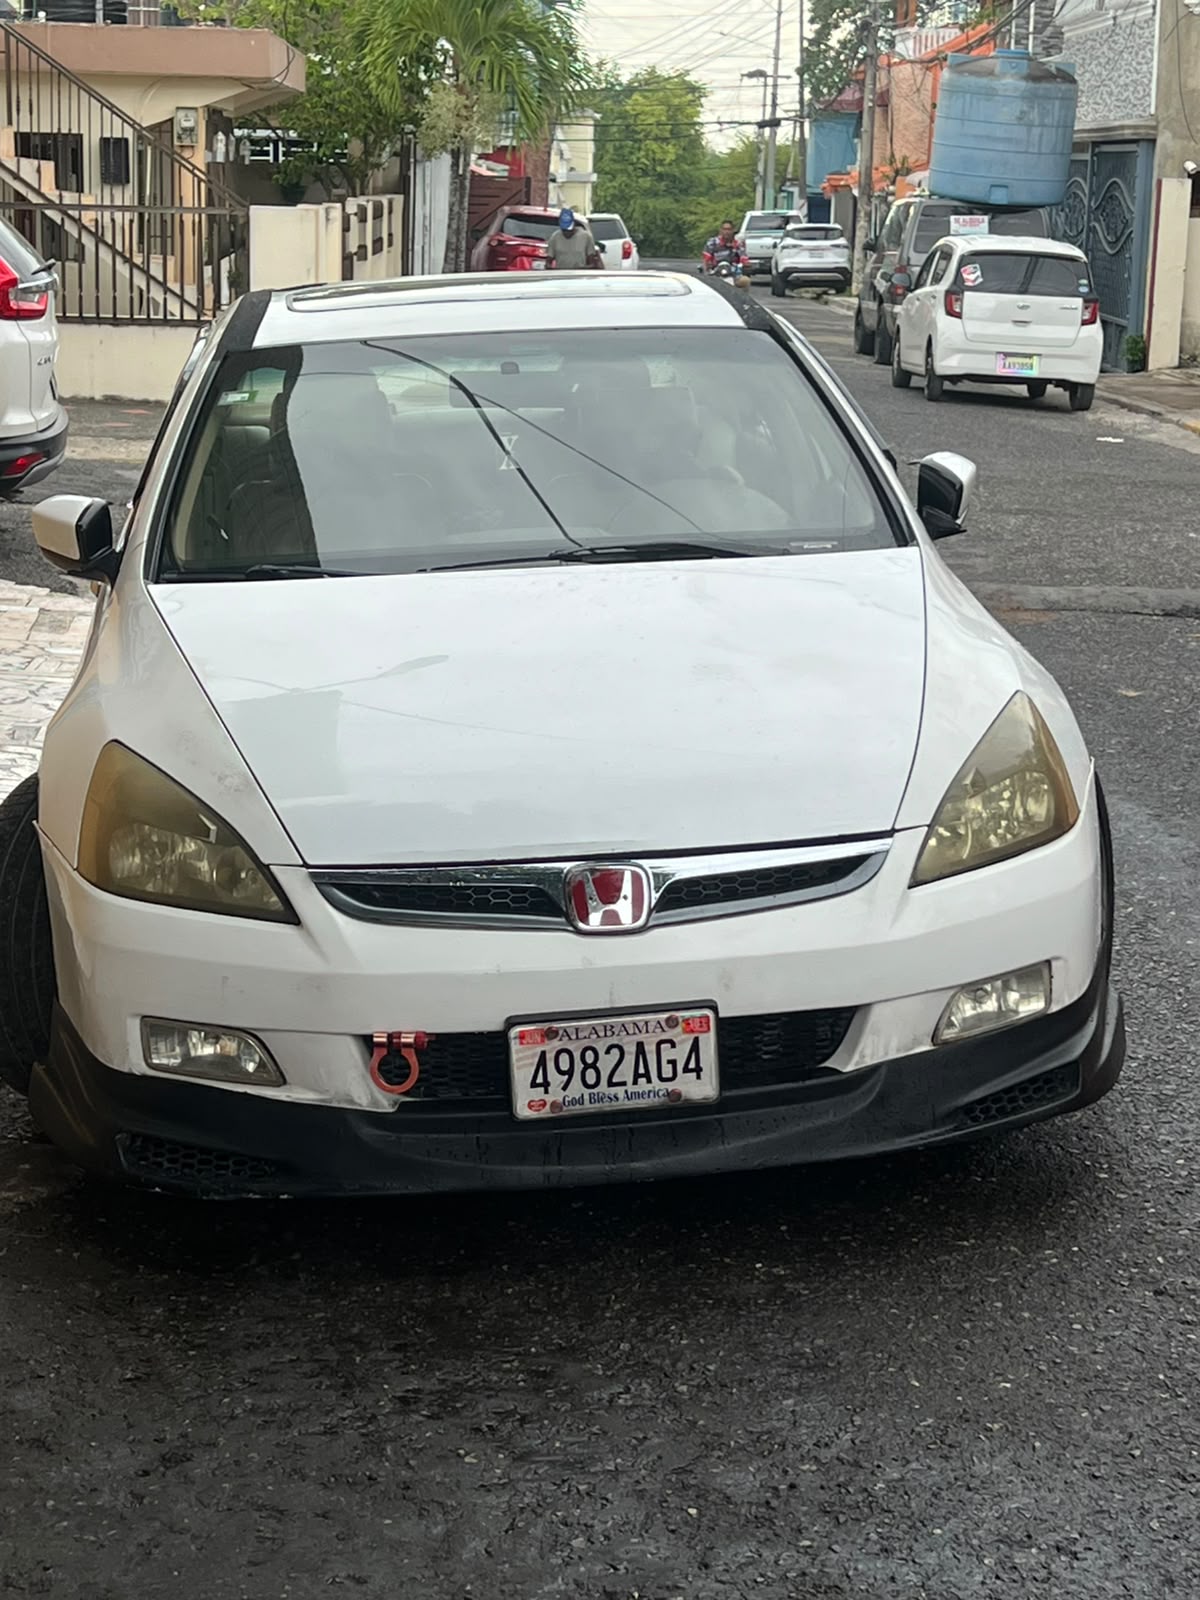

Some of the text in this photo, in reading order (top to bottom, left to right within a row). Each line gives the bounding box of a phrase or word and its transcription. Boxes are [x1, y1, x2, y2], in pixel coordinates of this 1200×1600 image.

[558, 1019, 667, 1041] ALABAMA
[530, 1035, 703, 1095] 4982AG4
[562, 1093, 585, 1108] God
[588, 1091, 619, 1105] Bless
[622, 1086, 670, 1102] America
